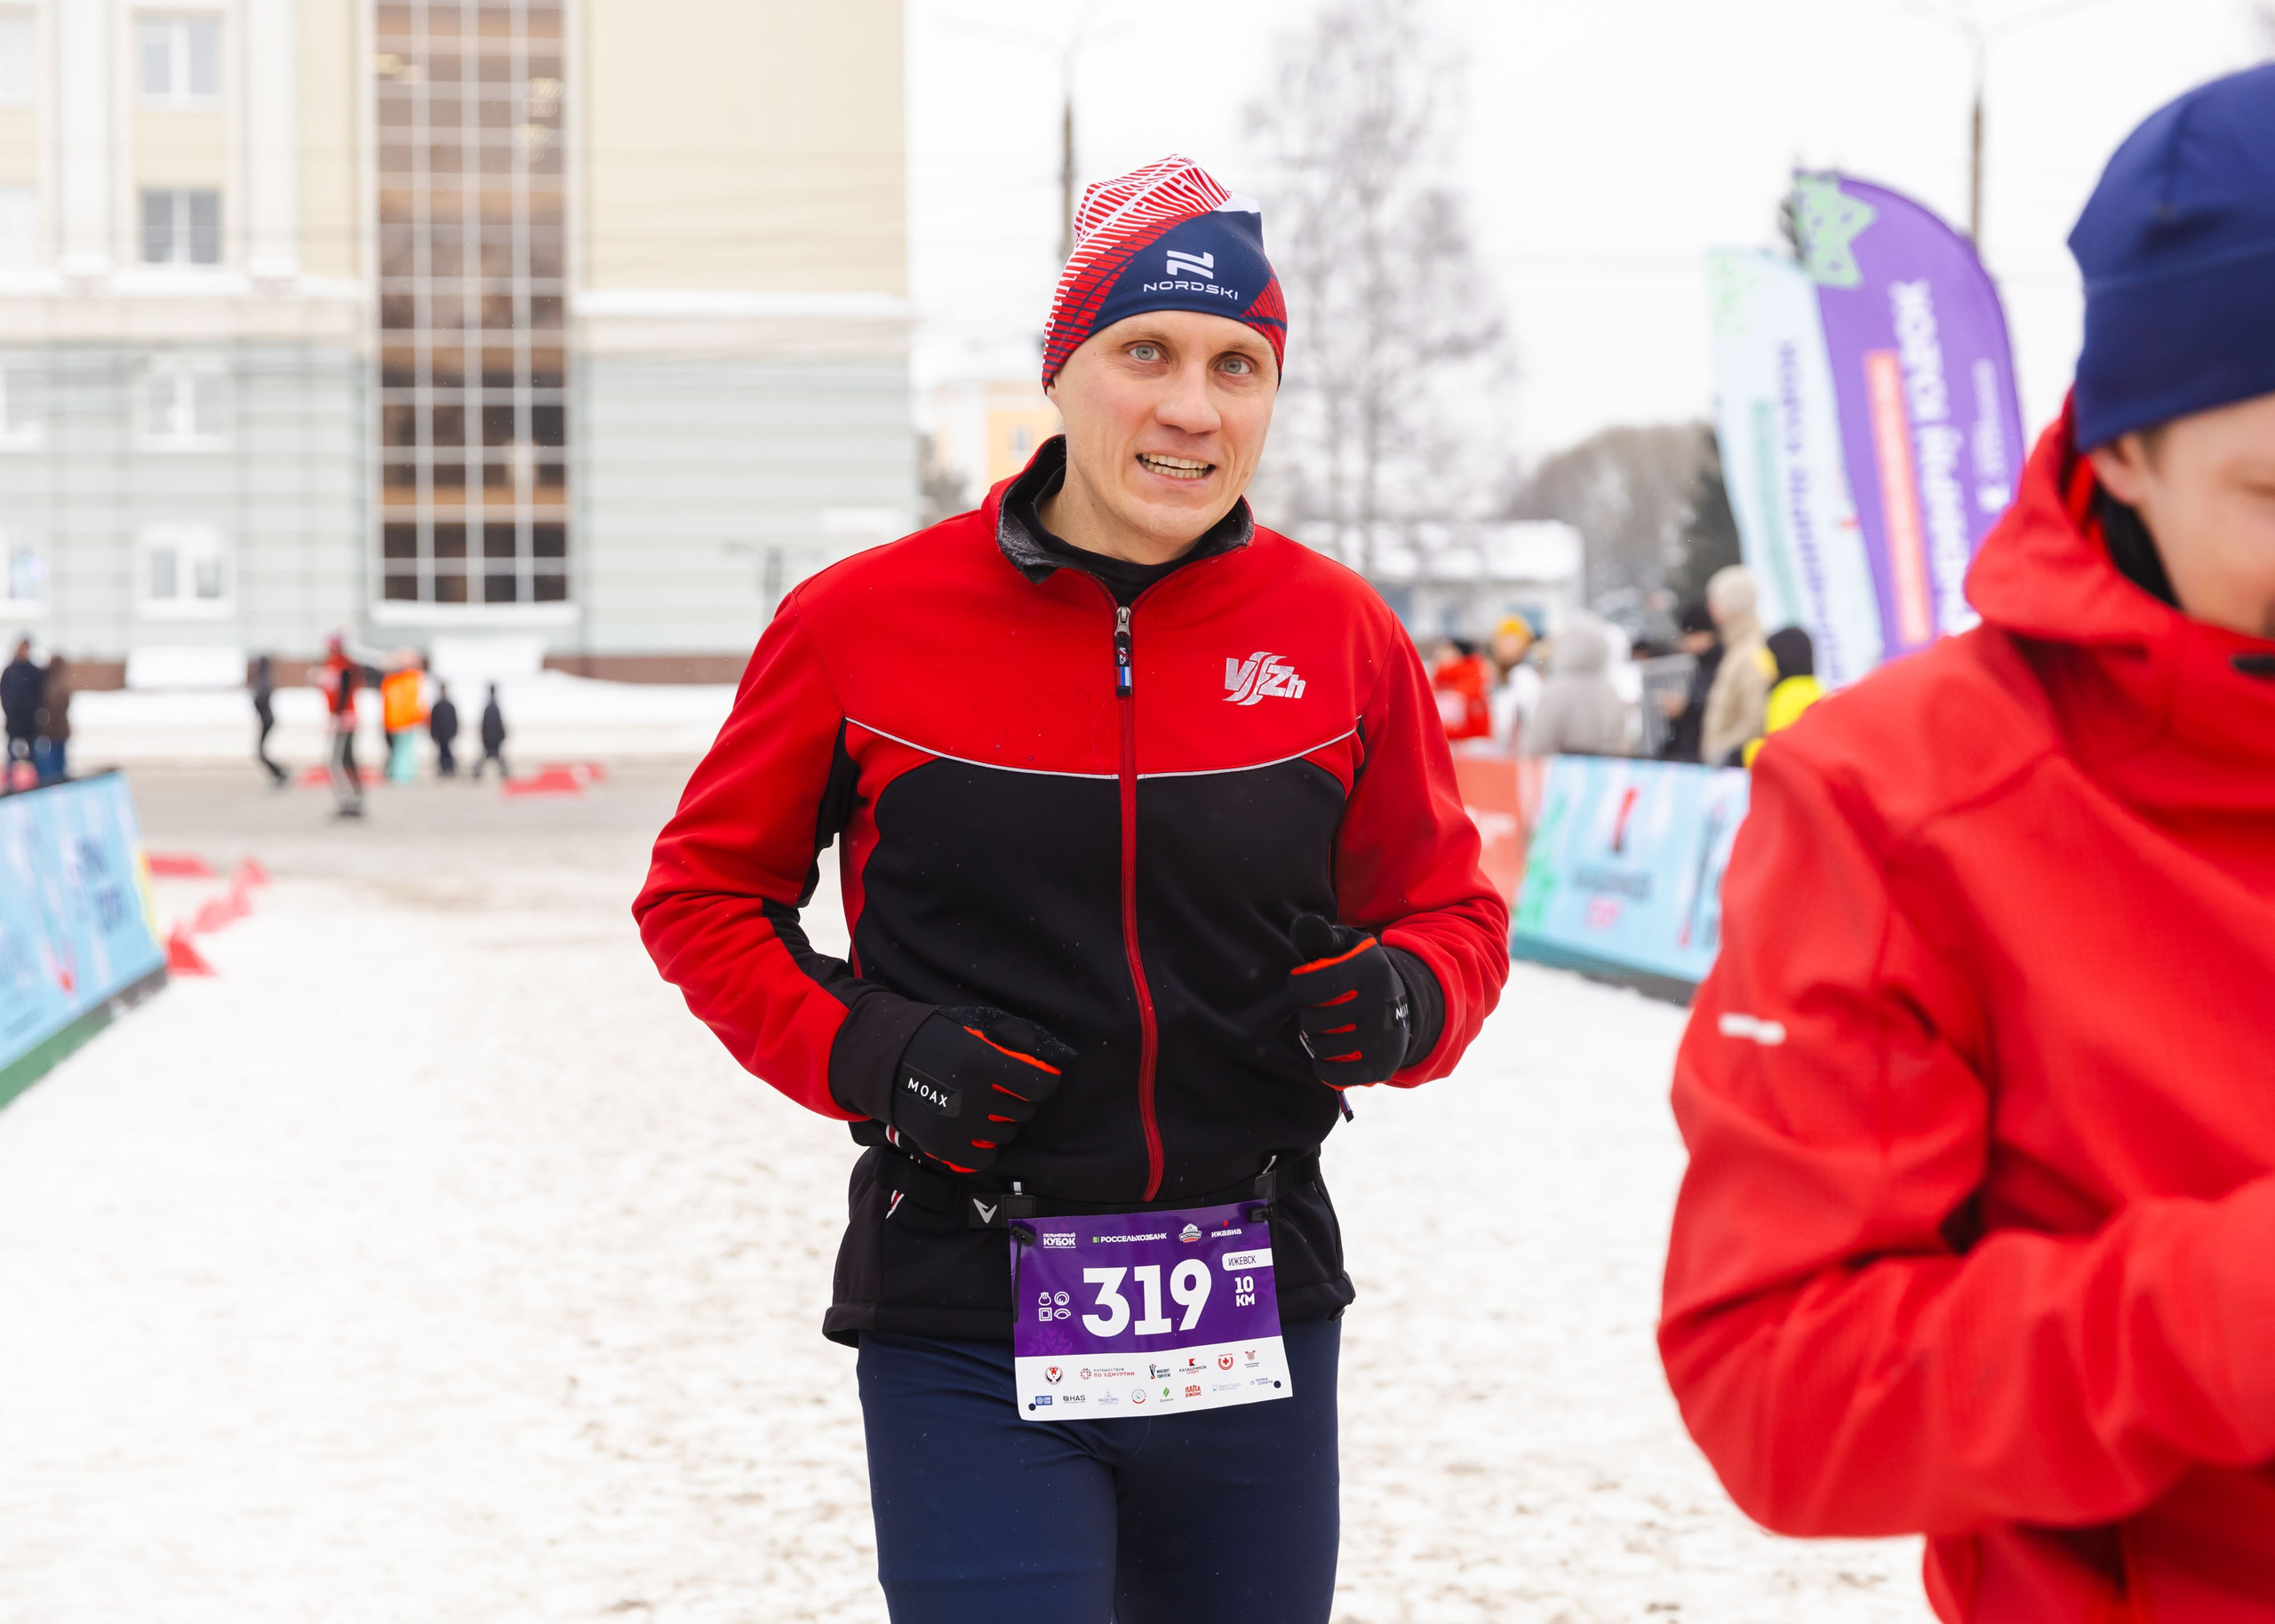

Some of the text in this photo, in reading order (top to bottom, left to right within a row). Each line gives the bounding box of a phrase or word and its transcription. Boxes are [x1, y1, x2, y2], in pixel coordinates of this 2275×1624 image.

[1144, 281, 1238, 300] NORDSKI
[907, 1078, 947, 1108] MOAX
[1101, 1232, 1167, 1243] РОССЕЛЬХОЗБАНК
[1228, 1255, 1257, 1266] ИЖЕВСК
[1234, 1276, 1254, 1294] 10
[1082, 1258, 1212, 1337] 319
[1235, 1294, 1255, 1307] КМ
